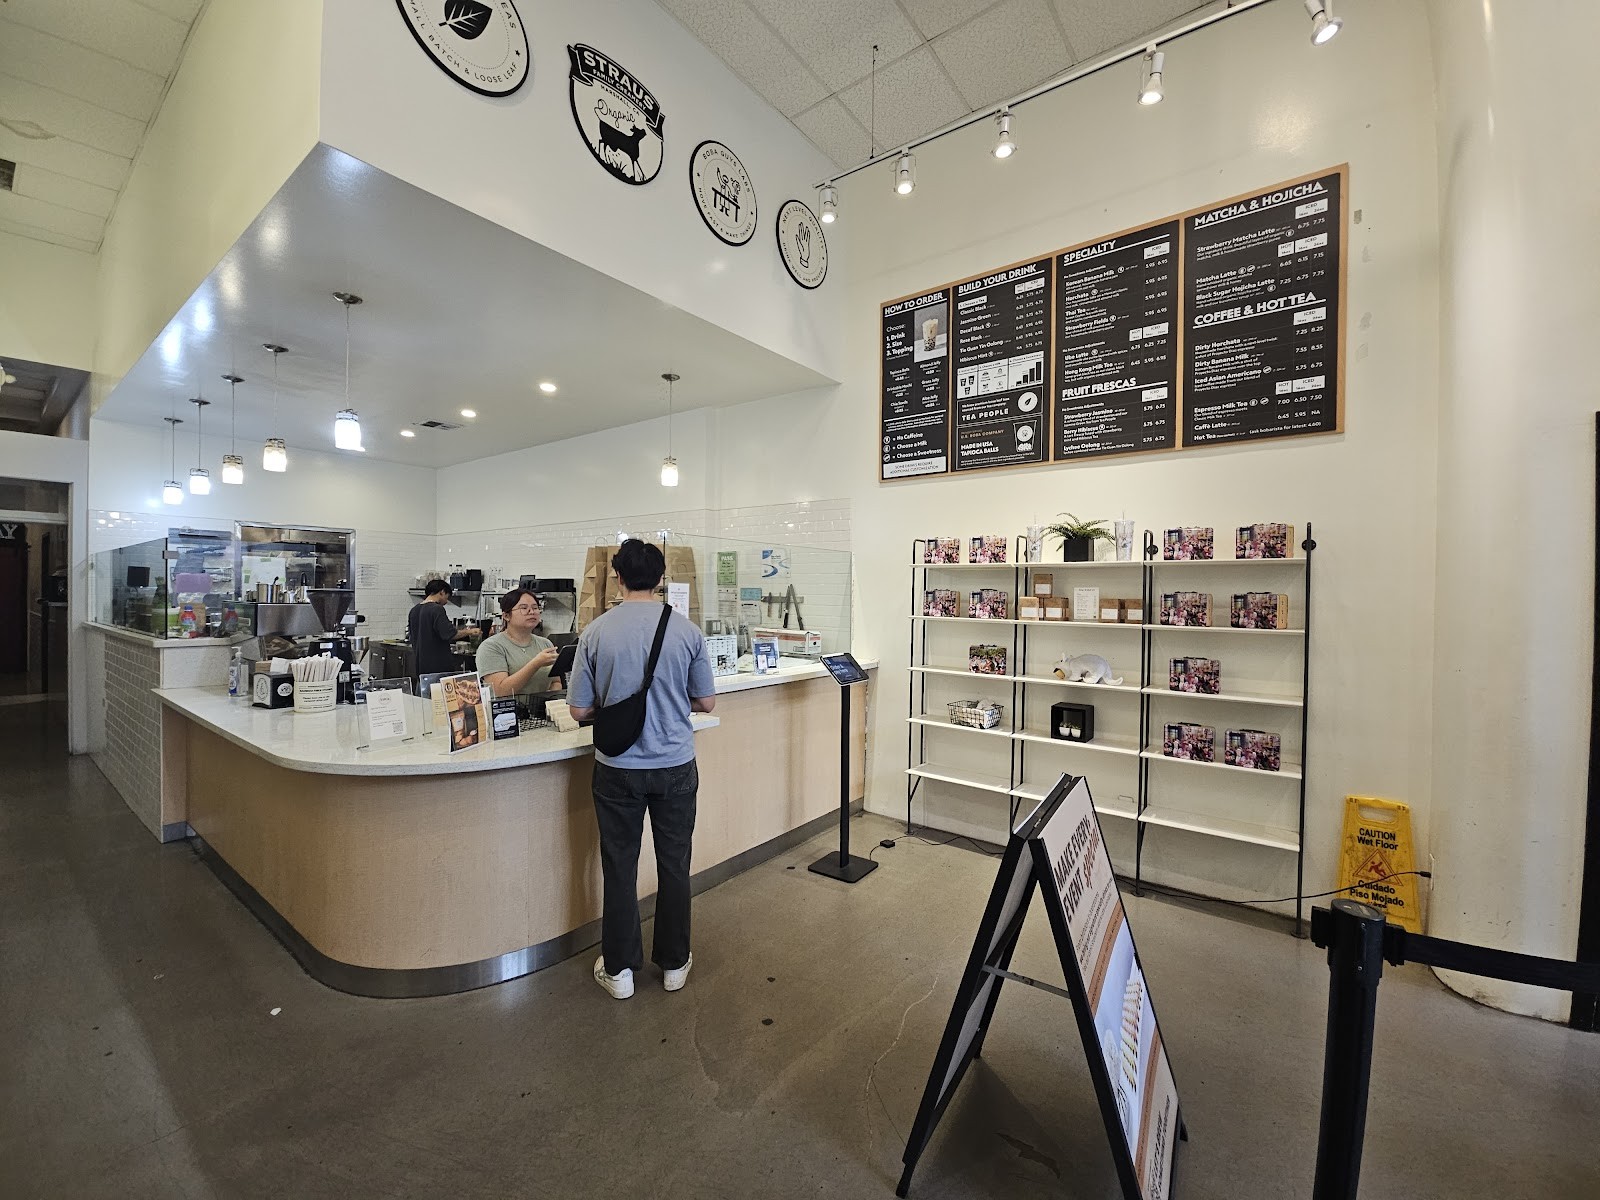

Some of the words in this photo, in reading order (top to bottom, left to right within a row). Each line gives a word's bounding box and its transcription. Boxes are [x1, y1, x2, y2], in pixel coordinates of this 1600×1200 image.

[428, 34, 460, 69] BATCH
[464, 67, 470, 75] &
[474, 72, 503, 83] LOOSE
[504, 62, 517, 80] LEAF
[583, 50, 654, 111] STRAUS
[592, 68, 615, 85] FAMILY
[615, 82, 647, 111] CREAMERY
[593, 98, 635, 129] Organic
[632, 107, 640, 117] CA
[702, 148, 719, 160] BOBA
[720, 150, 738, 167] GUYS
[738, 169, 750, 193] LABS
[1195, 204, 1248, 227] MATCHA
[1249, 199, 1260, 210] &
[1262, 181, 1324, 206] HOJICHA
[782, 206, 792, 224] NEXT
[791, 205, 808, 217] LEVEL
[808, 216, 825, 250] QUALITY
[1297, 221, 1310, 229] 6.75
[1312, 217, 1326, 226] 7.75
[1196, 238, 1232, 253] Strawberry
[1232, 233, 1257, 244] Matcha
[1257, 227, 1275, 237] Latte
[1063, 239, 1117, 264] SPECIALTY
[1279, 259, 1292, 267] 6.65
[1297, 255, 1309, 263] 6.15
[958, 281, 982, 294] BUILD
[982, 272, 1008, 288] YOUR
[1008, 263, 1037, 280] DRINK
[1065, 277, 1084, 287] Korean
[1083, 273, 1104, 283] Banana
[1103, 269, 1115, 278] Milk
[1196, 273, 1220, 284] Matcha
[1220, 270, 1237, 279] Latte
[1196, 291, 1213, 300] Black
[1212, 287, 1231, 298] Sugar
[1231, 282, 1257, 293] Hojicha
[1257, 278, 1275, 287] Latte
[884, 303, 904, 315] HOW
[903, 300, 916, 310] TO
[915, 292, 944, 306] ORDER
[1065, 292, 1089, 302] Horchata
[960, 308, 975, 316] Classic
[974, 304, 987, 312] Black
[1065, 309, 1077, 317] Thai
[1194, 306, 1242, 326] COFFEE
[1243, 304, 1254, 316] &
[1256, 296, 1287, 313] HOT
[1286, 291, 1317, 306] TEA
[960, 317, 977, 326] Jasmine
[976, 313, 992, 321] Green
[1065, 320, 1093, 332] Strawberry
[1093, 317, 1109, 326] Fields
[886, 323, 907, 333] Choose:
[960, 326, 973, 335] Decaf
[972, 324, 985, 332] Black
[1295, 328, 1308, 336] 7.25
[890, 331, 906, 341] Drink
[970, 334, 983, 342] Black
[891, 340, 903, 348] Size
[891, 345, 914, 356] Topping
[966, 344, 980, 352] Guan
[986, 339, 1004, 348] Oolong
[1195, 343, 1211, 352] Dirty
[1211, 338, 1241, 349] Horchata
[960, 353, 978, 363] Hibiscus
[977, 351, 988, 359] Mint
[1075, 351, 1089, 359] Latte
[1195, 359, 1211, 368] Dirty
[1211, 356, 1235, 366] Banana
[1235, 353, 1249, 361] Milk
[1064, 368, 1079, 377] Hong
[1078, 365, 1093, 374] Kong
[1092, 362, 1104, 370] Milk
[1310, 361, 1323, 369] 6.75
[1194, 376, 1209, 385] Iced
[1208, 373, 1227, 382] Asian
[1227, 369, 1262, 380] Americano
[1062, 385, 1091, 398] FRUIT
[1091, 377, 1137, 394] FRESCAS
[1277, 397, 1291, 405] 7.00
[1294, 395, 1307, 403] 6.50
[1309, 393, 1323, 401] 7.50
[978, 408, 1009, 419] PEOPLE
[1194, 404, 1222, 414] Espresso
[1222, 402, 1236, 410] Milk
[1236, 400, 1248, 408] Tea
[1064, 412, 1092, 421] Strawberry
[1092, 408, 1114, 417] Jasmine
[1063, 428, 1078, 437] Berry
[1077, 425, 1099, 434] Hibiscus
[1194, 422, 1211, 431] Caffè
[1211, 421, 1227, 429] Latte
[1194, 433, 1206, 441] Hot
[1206, 432, 1217, 440] Tea
[1259, 425, 1283, 434] bobarista
[1291, 422, 1307, 430] latest:
[903, 432, 924, 440] Caffeine
[981, 429, 1005, 437] COMPANY
[960, 443, 976, 451] MADE
[982, 440, 994, 448] USA
[960, 448, 984, 457] TAPIOCA
[983, 446, 1000, 454] BALLS
[1063, 443, 1081, 452] Lychee
[1080, 441, 1101, 450] Oolong
[896, 451, 914, 459] Choose
[917, 448, 942, 457] Sweetness
[1359, 827, 1397, 842] CAUTION
[1357, 835, 1374, 848] Wet
[1375, 839, 1399, 851] Floor
[1053, 841, 1076, 893] MAKE
[1070, 814, 1092, 859] EVERY
[1357, 879, 1396, 895] Cuidado
[1062, 866, 1085, 925] EVENT
[1349, 887, 1369, 900] Piso
[1371, 891, 1405, 907] Mojado
